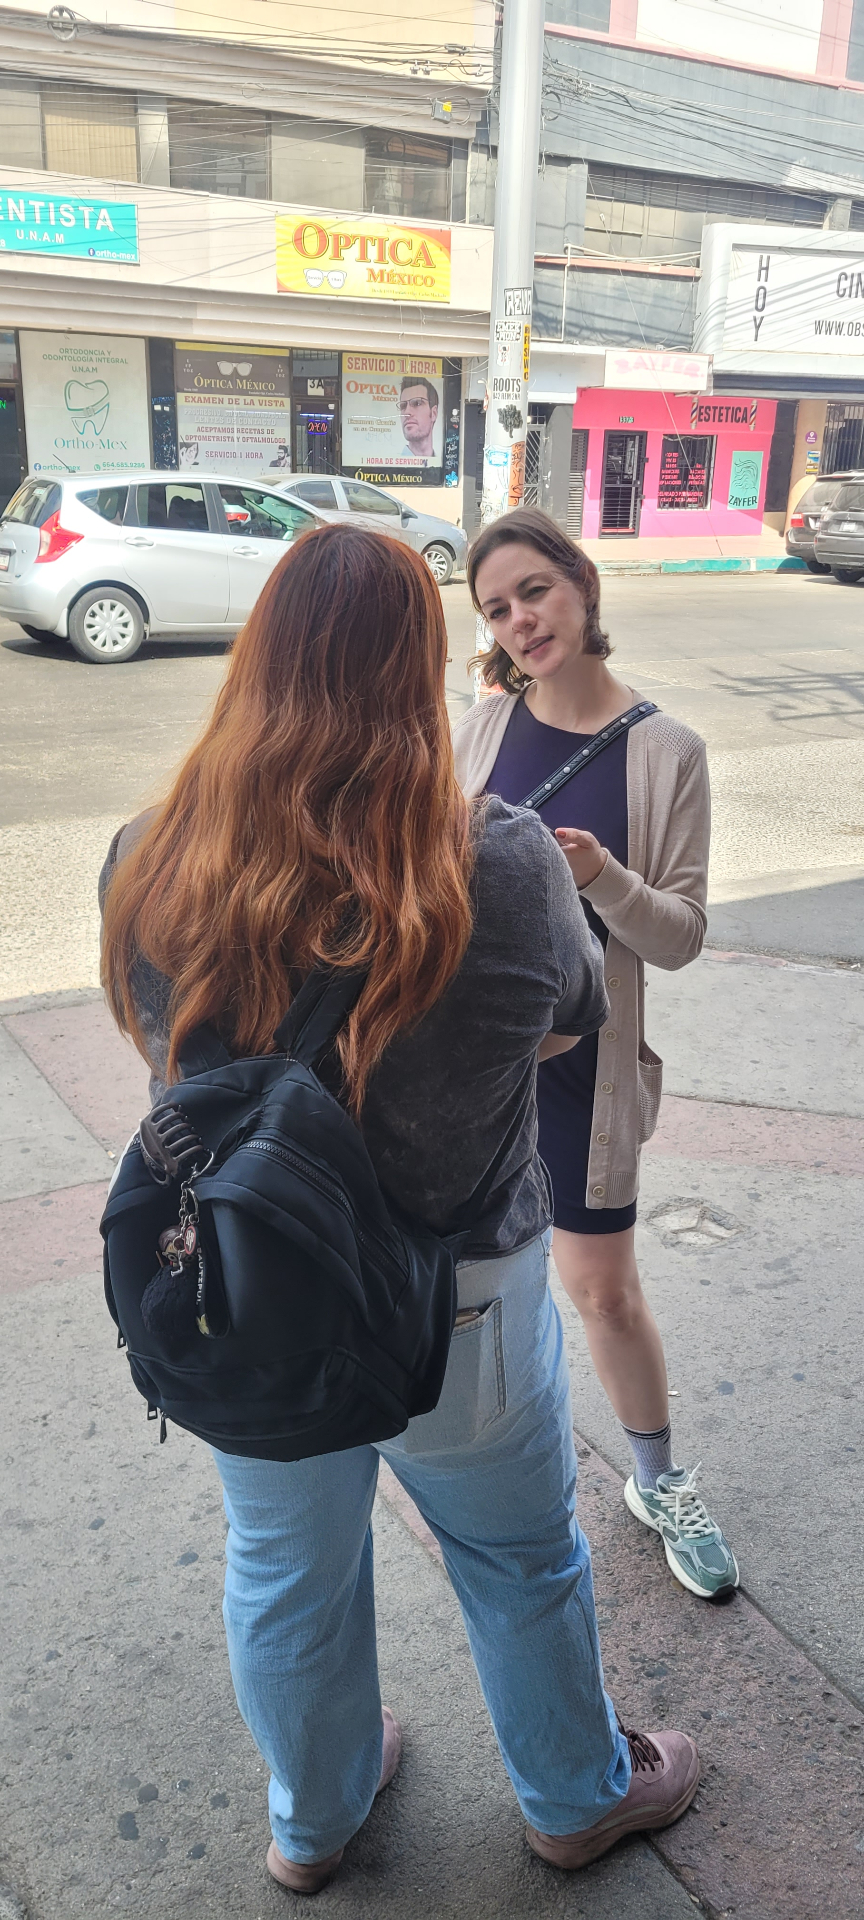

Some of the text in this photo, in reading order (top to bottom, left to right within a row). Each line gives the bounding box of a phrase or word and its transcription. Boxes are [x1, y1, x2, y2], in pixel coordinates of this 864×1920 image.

[0, 197, 114, 232] NTISTA
[16, 229, 64, 244] U.N.A.M
[292, 222, 436, 268] OPTICA
[96, 250, 136, 260] ortho-mex
[366, 268, 436, 288] MÉXICO
[42, 354, 94, 363] ODONTOLOGÍA
[347, 357, 437, 374] SERVICIO 1 HORA
[194, 373, 275, 391] ÓPTICA MÉXICO
[346, 380, 398, 395] OPTICA
[493, 378, 521, 392] ROOTS
[184, 395, 224, 404] EXAMEN
[698, 405, 748, 423] ESTETICA
[54, 437, 128, 450] Ortho-Mex
[355, 468, 422, 482] ÓPTICA MÉXICO
[728, 495, 758, 507] ZAYFER
